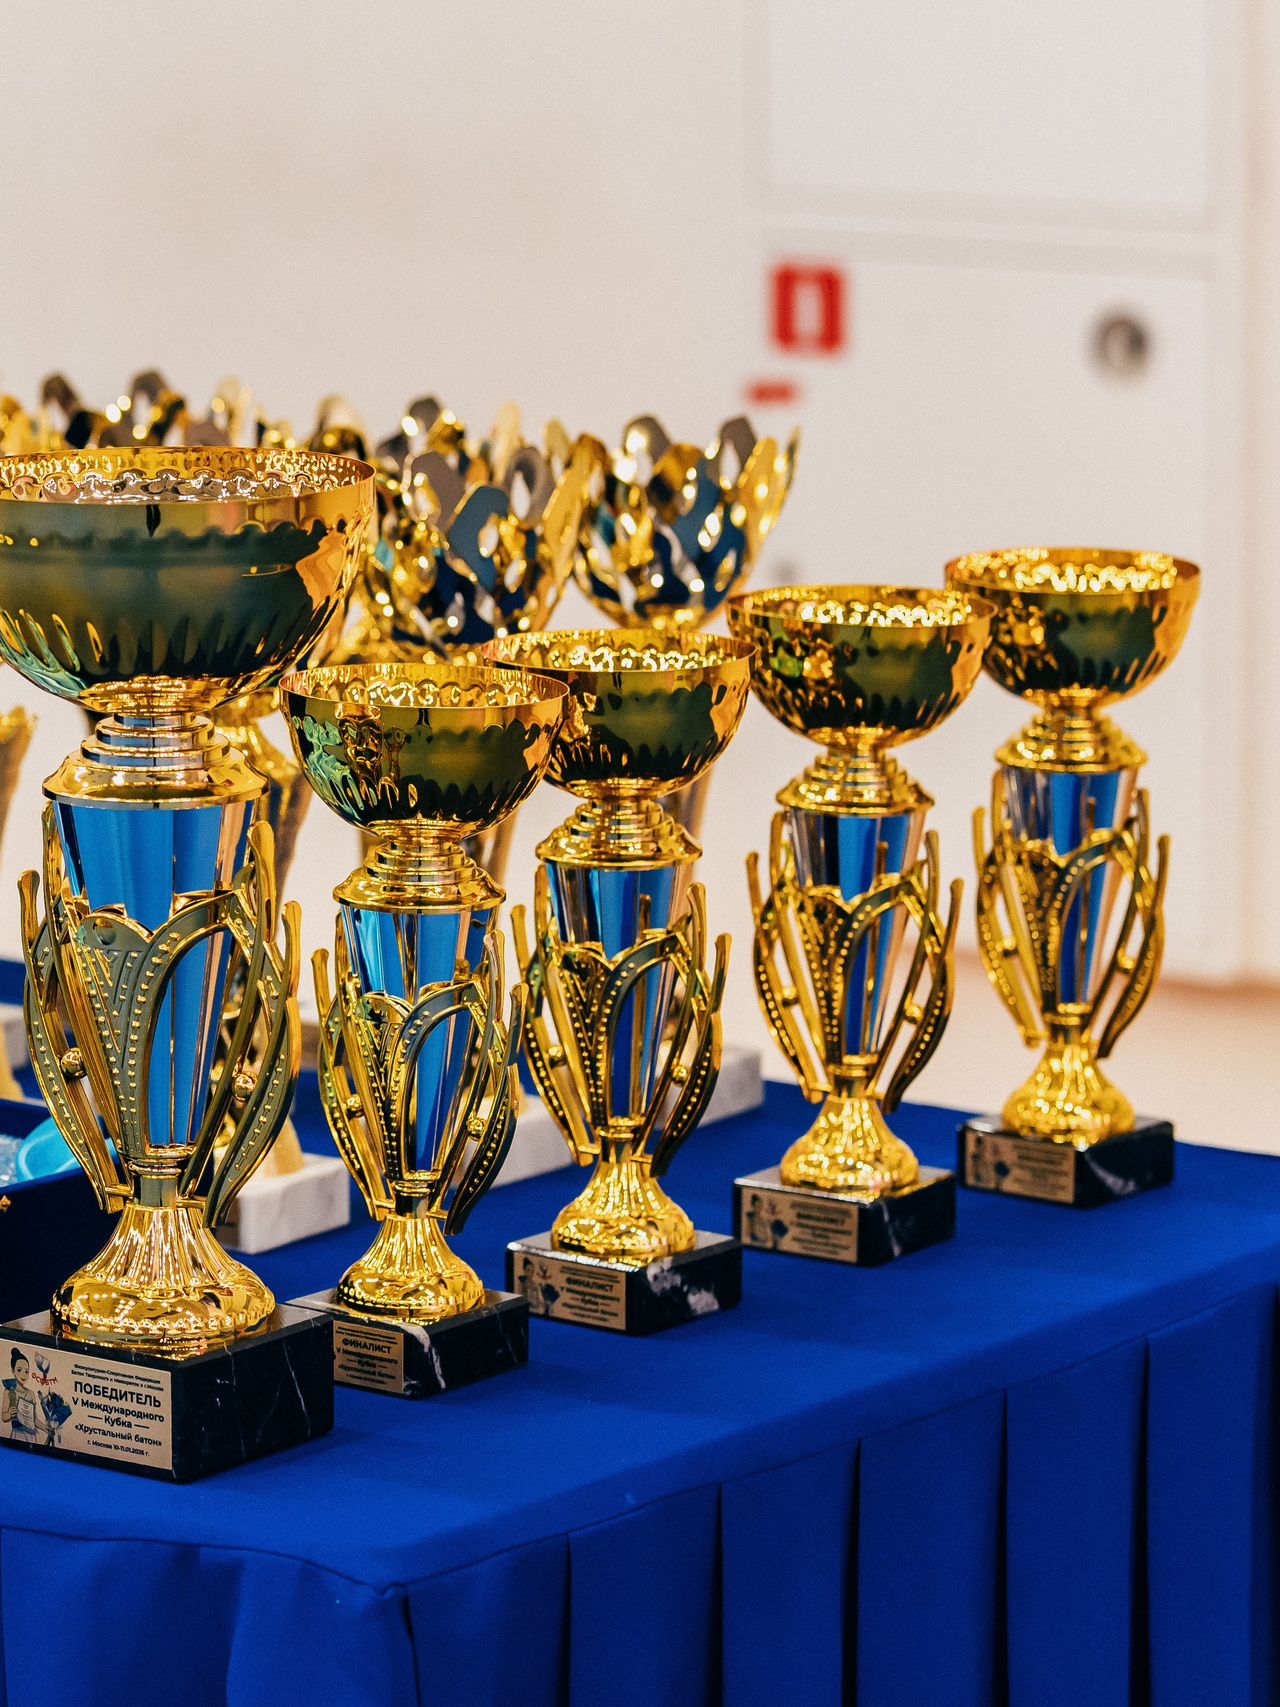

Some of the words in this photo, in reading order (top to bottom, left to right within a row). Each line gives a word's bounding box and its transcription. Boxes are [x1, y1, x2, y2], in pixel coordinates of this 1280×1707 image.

[342, 1338, 391, 1354] ФИНАЛИСТ
[74, 1381, 161, 1408] ПОБЕДИТЕЛЬ
[72, 1396, 79, 1405] V
[81, 1398, 164, 1422] Международного
[104, 1415, 132, 1429] Кубка
[75, 1423, 132, 1441] «Хрустальный
[134, 1434, 162, 1446] батон»
[92, 1440, 113, 1449] Москва
